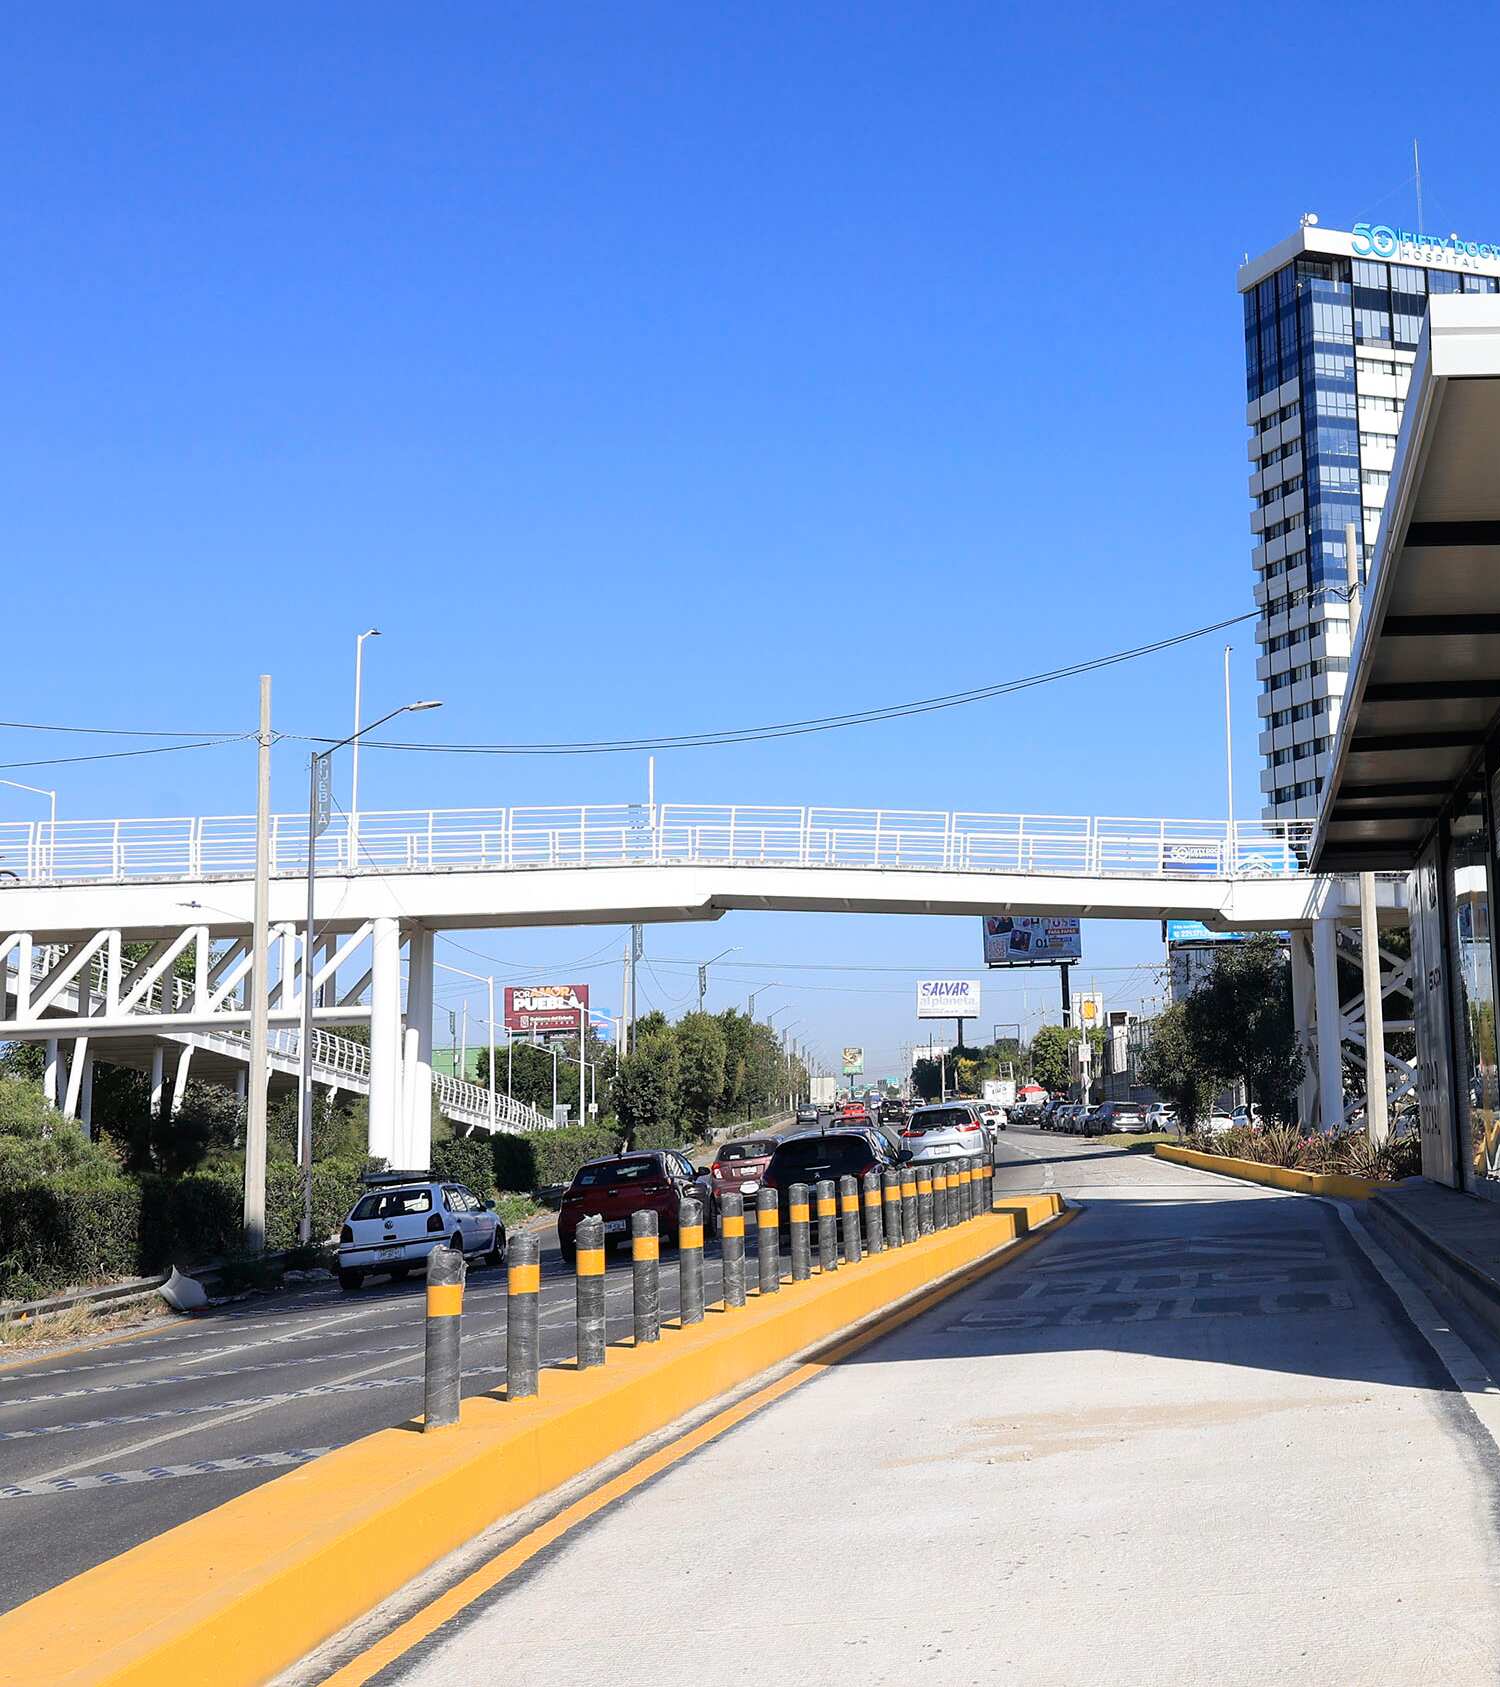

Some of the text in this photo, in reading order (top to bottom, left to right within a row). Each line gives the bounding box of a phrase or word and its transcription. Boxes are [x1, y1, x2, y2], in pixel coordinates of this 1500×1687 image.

[1352, 222, 1398, 258] 50
[1402, 231, 1449, 254] FIFTY
[1402, 249, 1480, 270] HOSPITAL
[318, 758, 329, 825] PUEBLA
[513, 990, 532, 999] POR
[530, 986, 570, 998] AMOR
[922, 982, 969, 996] SALVAR
[513, 997, 578, 1011] PUEBLA
